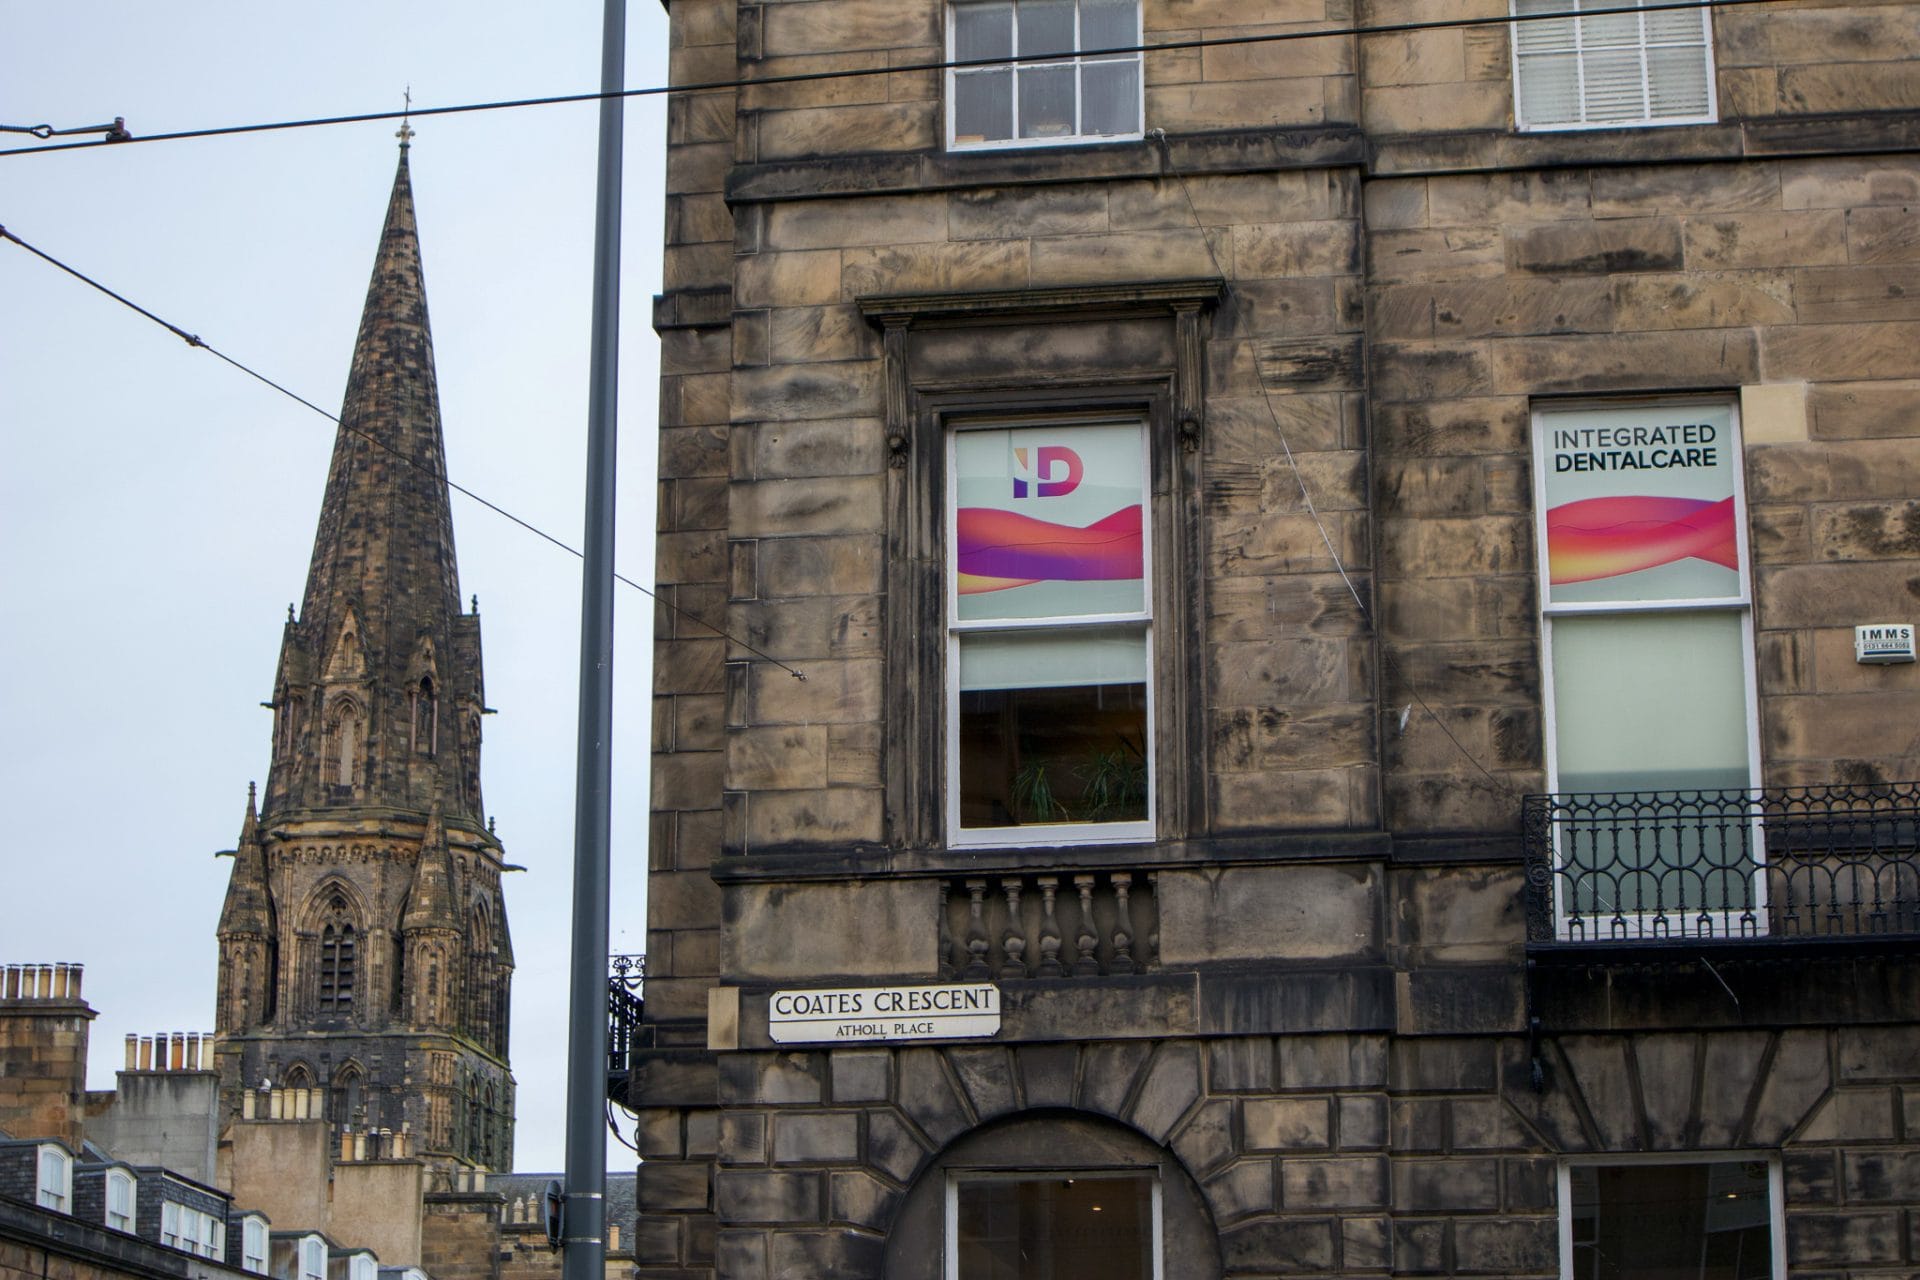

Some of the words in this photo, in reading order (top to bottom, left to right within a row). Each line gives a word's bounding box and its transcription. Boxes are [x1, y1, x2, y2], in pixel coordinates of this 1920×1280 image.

[1554, 424, 1716, 449] INTEGRATED
[1555, 447, 1717, 472] DENTALCARE
[1862, 628, 1910, 640] IMMS
[775, 993, 862, 1015] COATES
[874, 988, 994, 1011] CRESCENT
[836, 1023, 887, 1037] ATHOLL
[894, 1022, 934, 1035] PLACE
